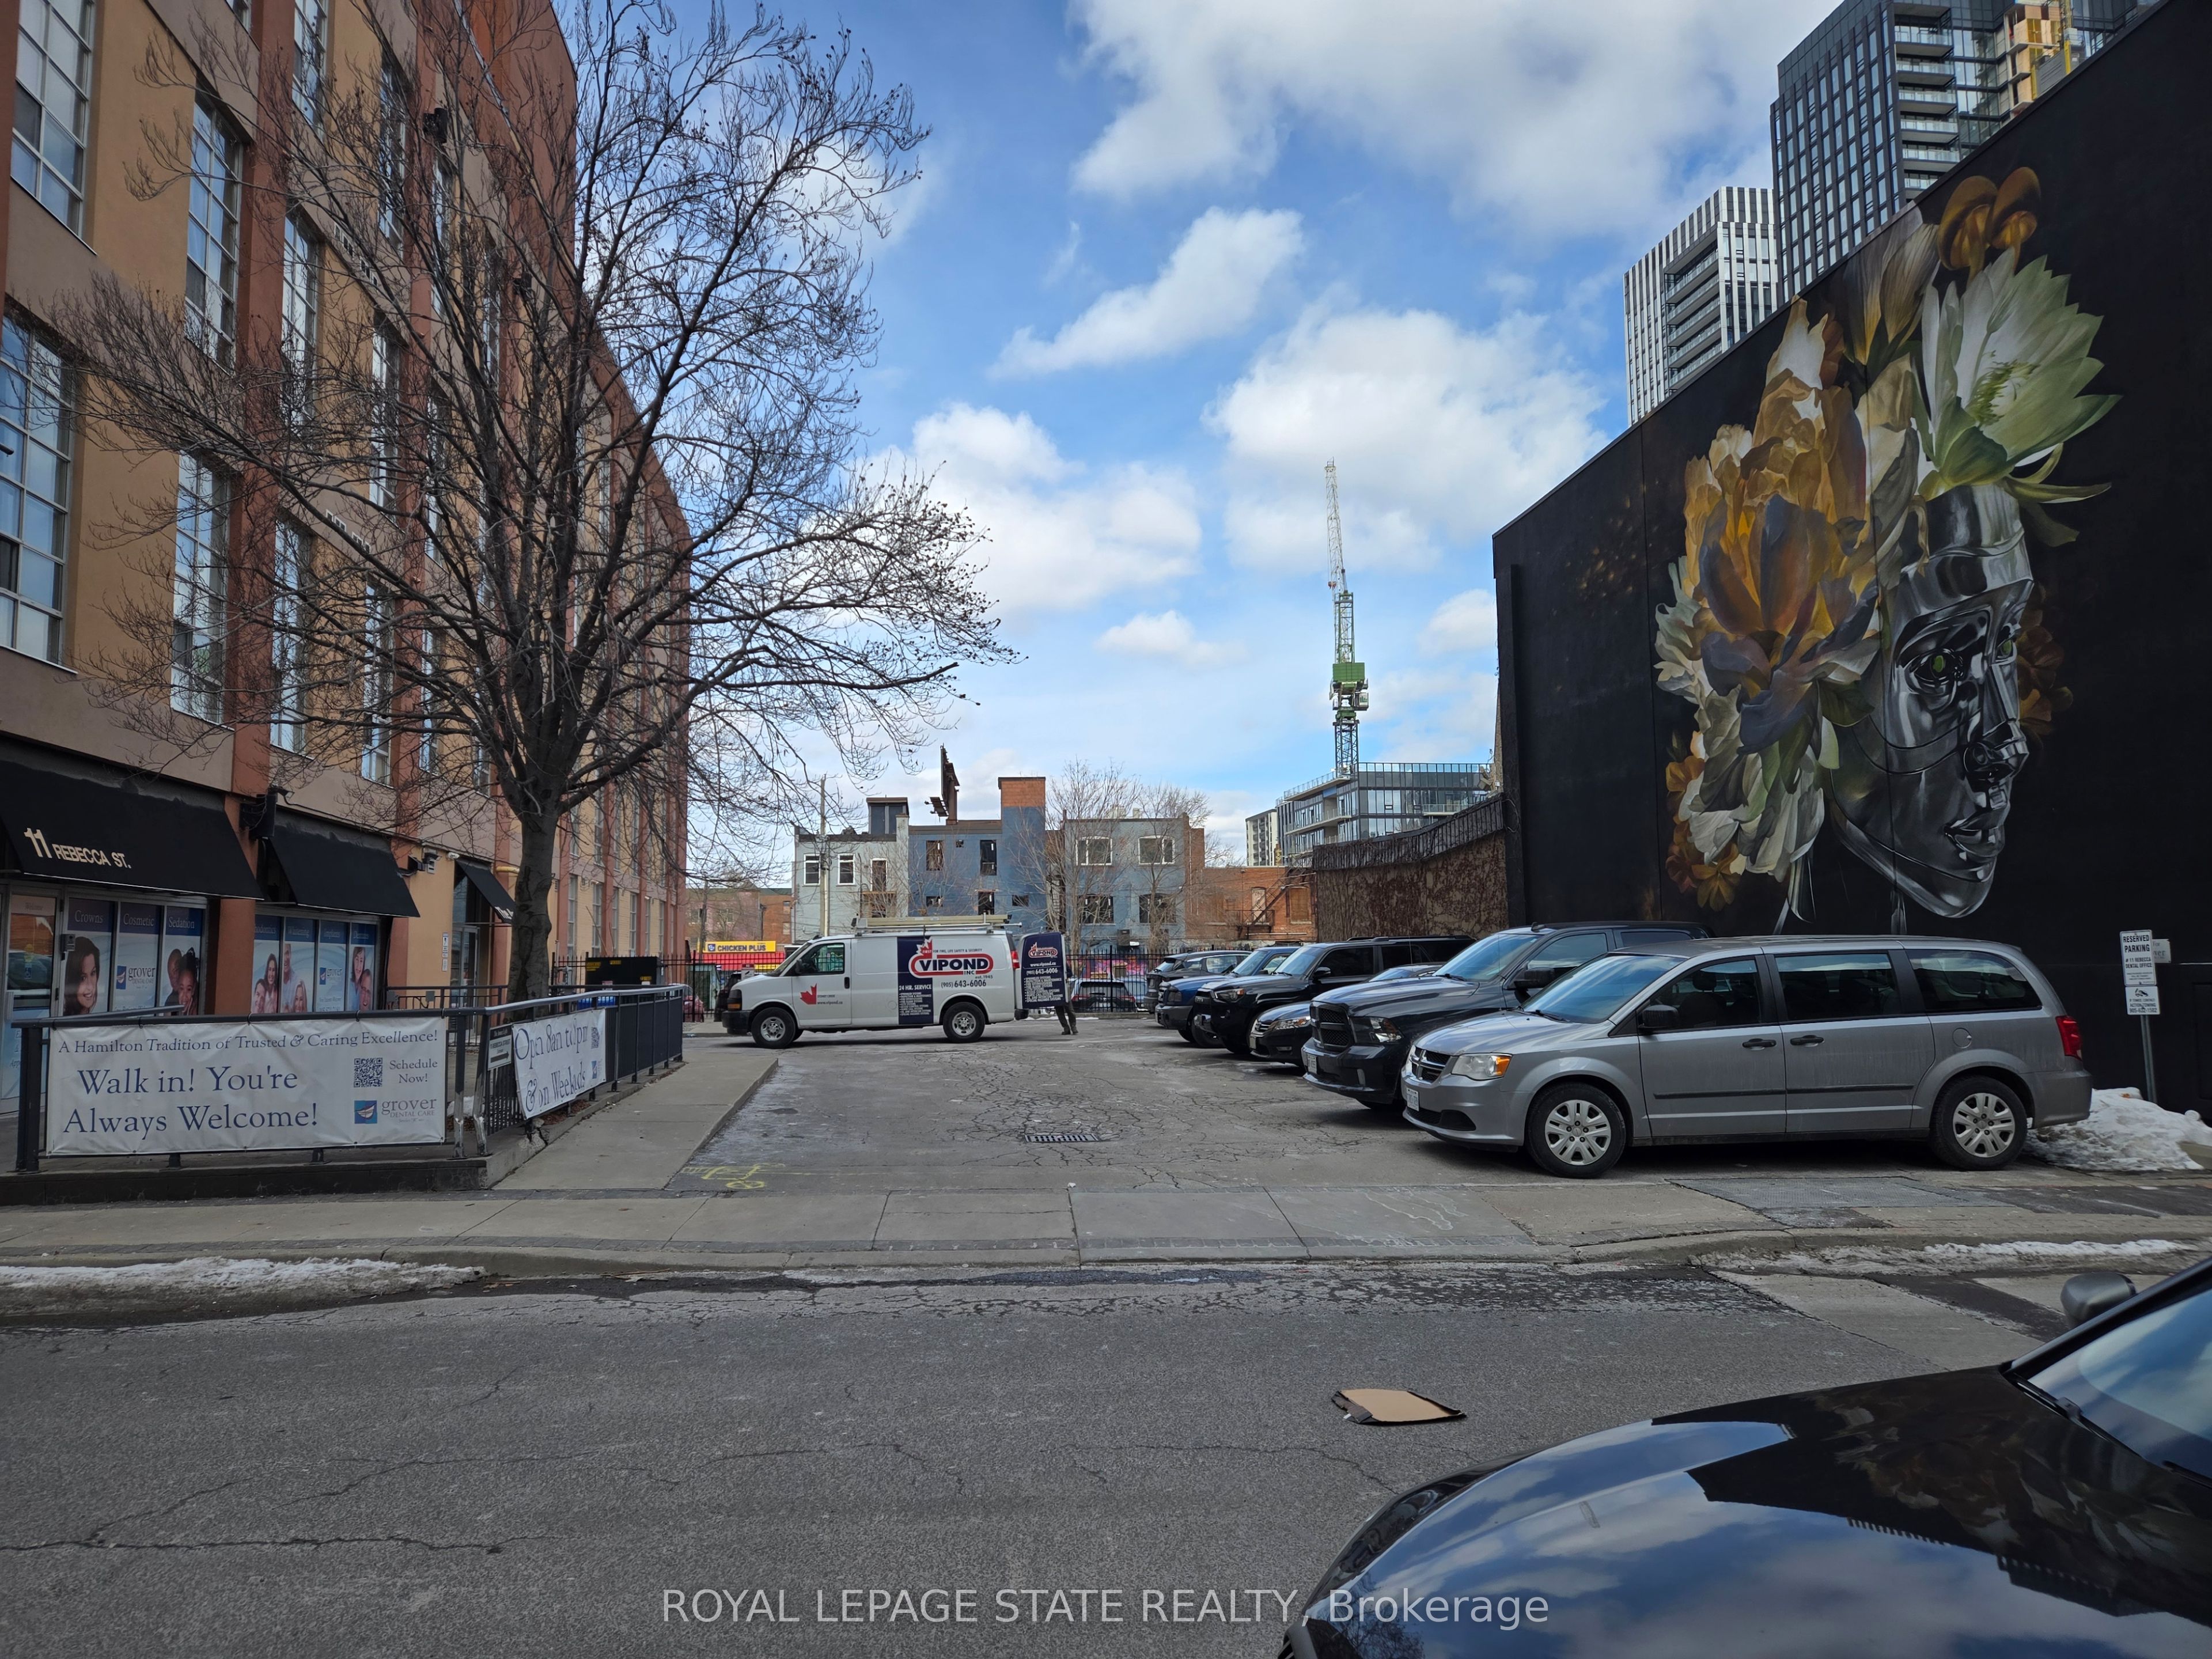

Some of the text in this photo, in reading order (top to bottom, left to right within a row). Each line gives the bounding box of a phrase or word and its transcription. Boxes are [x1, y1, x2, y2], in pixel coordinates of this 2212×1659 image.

[24, 827, 131, 869] 11 REBECCA ST.
[75, 910, 103, 923] Crowns
[123, 913, 154, 927] Cosmetic
[168, 916, 195, 929] Sedation
[2124, 944, 2150, 953] PARKING
[919, 959, 988, 971] VIPOND
[128, 967, 156, 981] grover
[59, 1030, 438, 1052] A Hamilton Tradition of Trusted & Caring Excellence!
[389, 1058, 438, 1070] Schedule
[77, 1065, 297, 1094] Walk in! You're
[399, 1073, 428, 1084] Now!
[526, 1078, 537, 1112] &
[382, 1099, 437, 1115] grover
[63, 1103, 317, 1140] Always Welcome!
